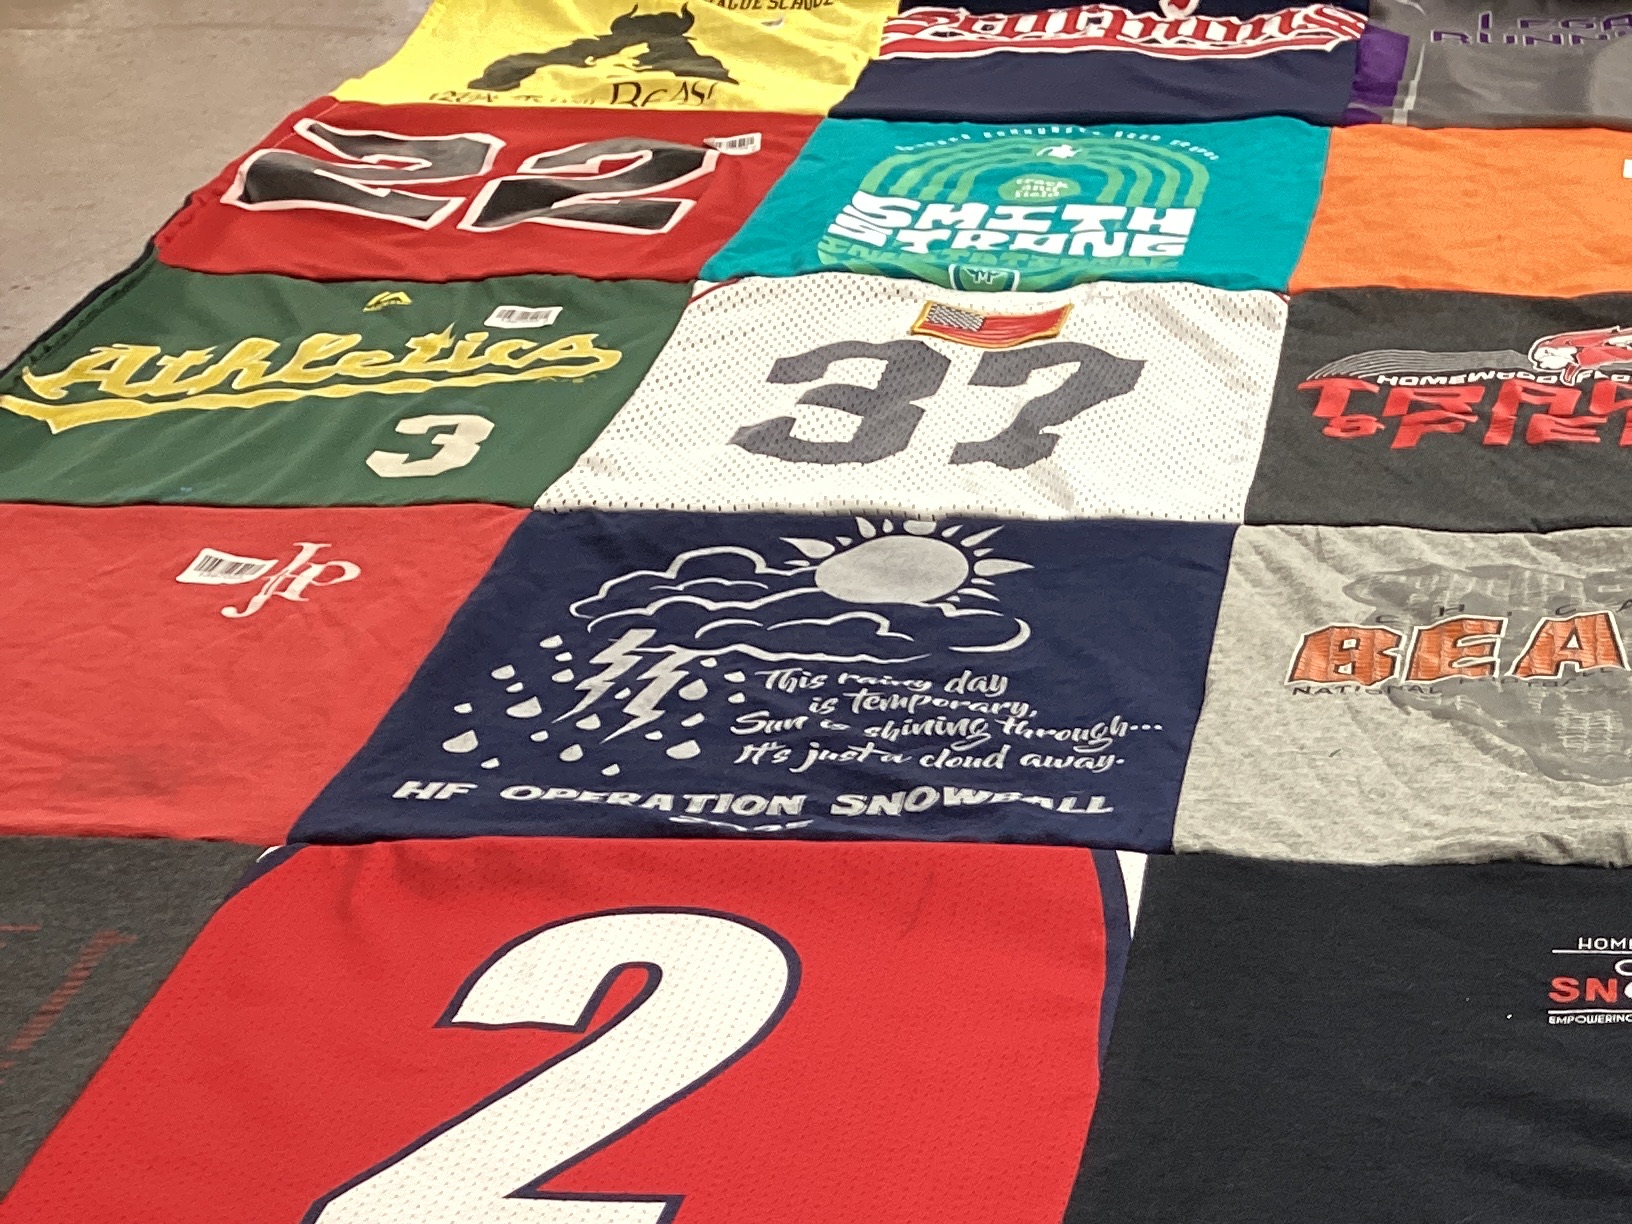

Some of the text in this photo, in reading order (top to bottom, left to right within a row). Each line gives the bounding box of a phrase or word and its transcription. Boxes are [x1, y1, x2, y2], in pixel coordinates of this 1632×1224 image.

[220, 118, 720, 234] 22
[848, 190, 1197, 235] SMITH
[828, 215, 1189, 257] STRONG
[21, 323, 623, 399] Athletics
[1376, 370, 1561, 385] HOMEWOOD
[729, 339, 1148, 471] 37
[366, 413, 495, 478] 3
[754, 668, 828, 694] This
[944, 670, 1009, 696] day
[808, 690, 1038, 719] is temporary,
[730, 711, 808, 736] Sun
[863, 716, 993, 751] shining
[732, 742, 791, 765] It's
[919, 744, 1007, 769] cloud
[392, 781, 1114, 817] HF OPERATION SNOWBALL
